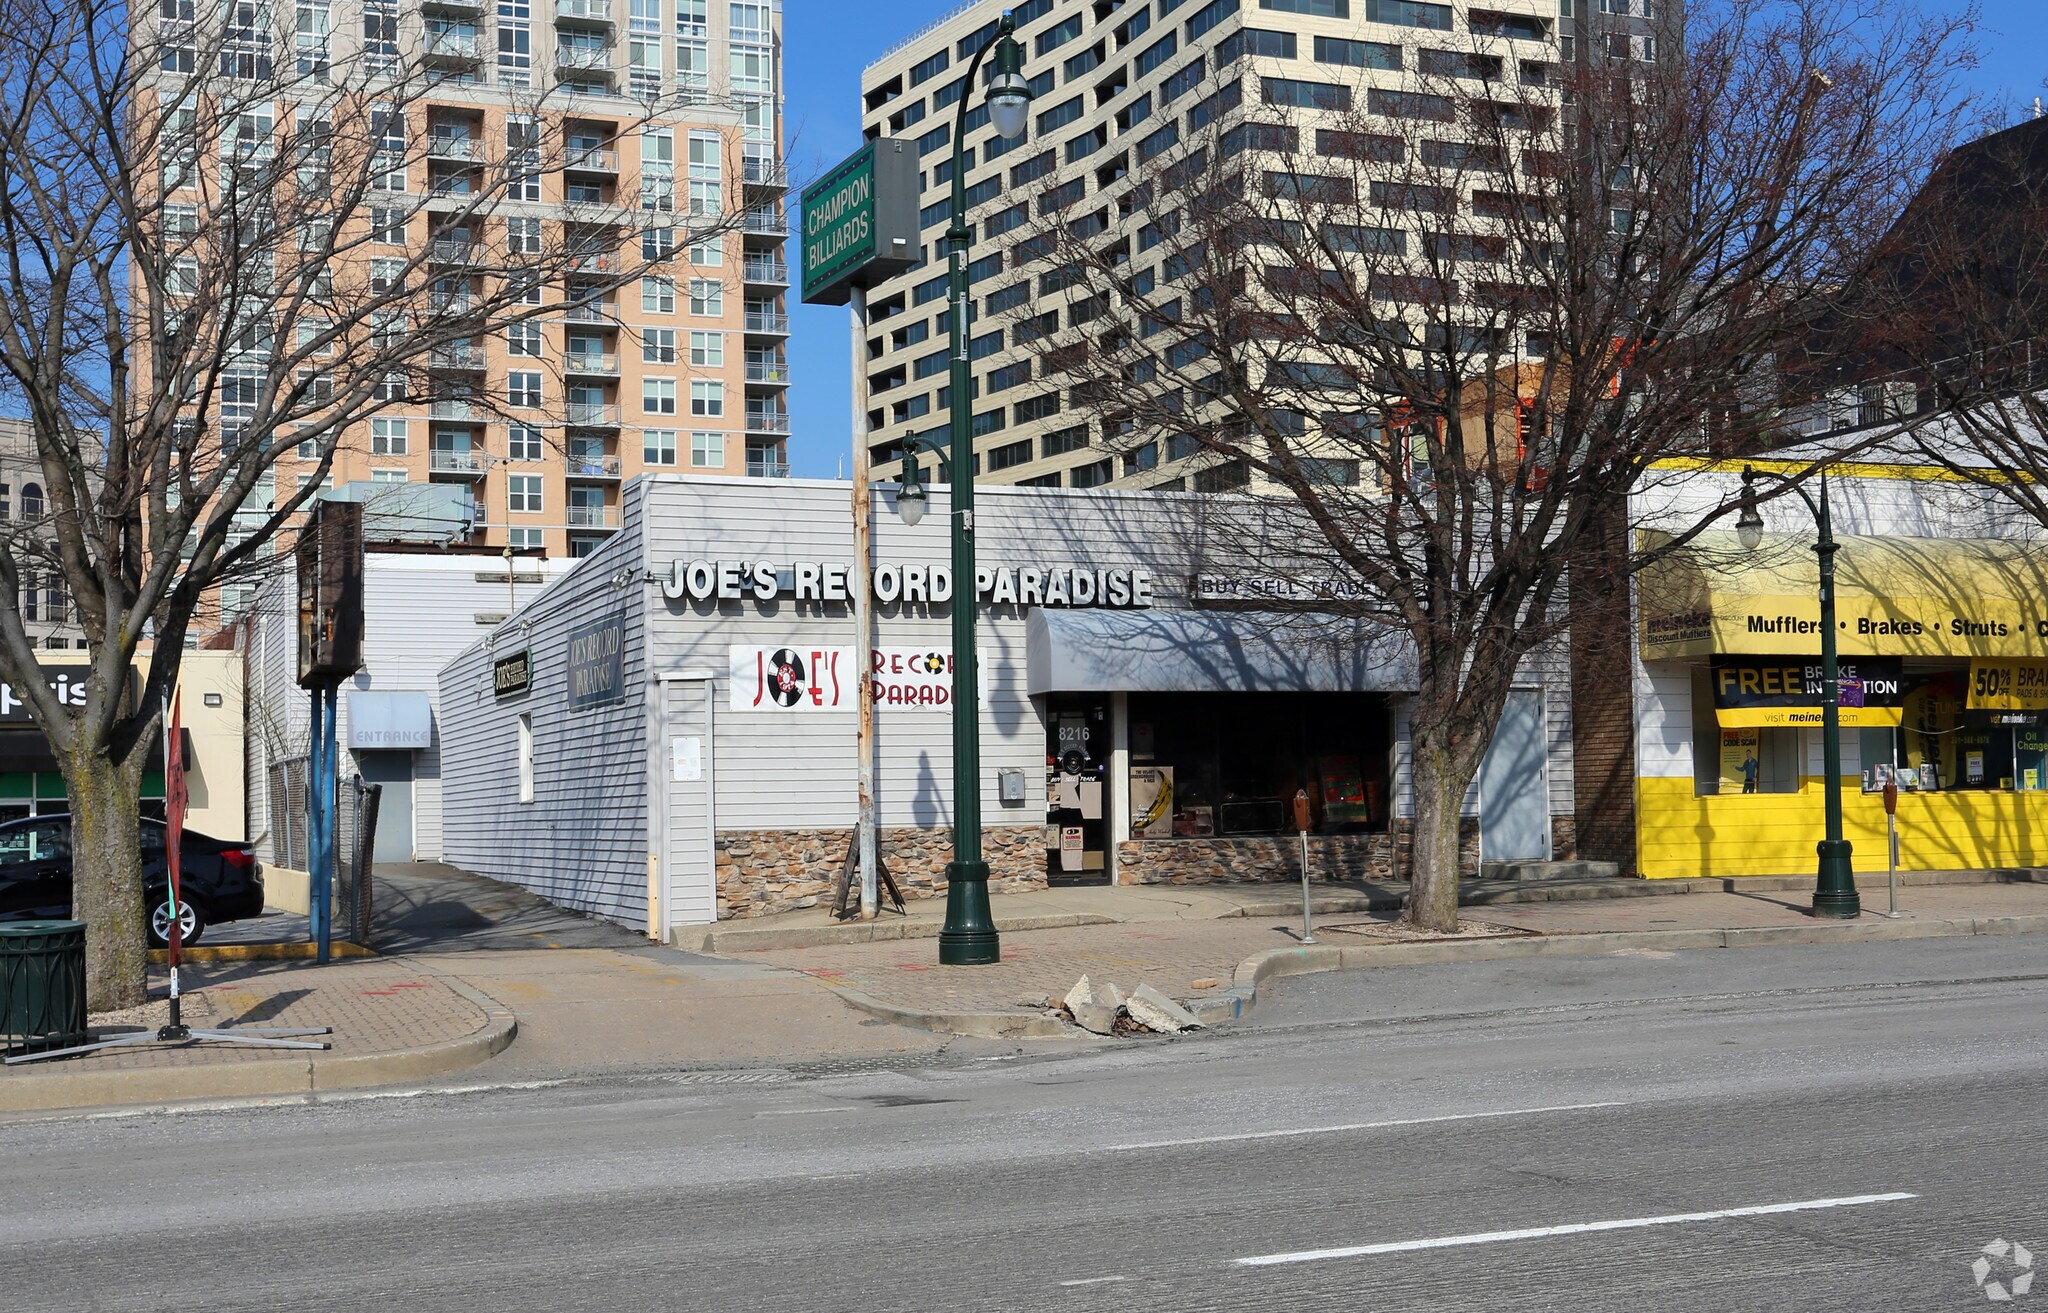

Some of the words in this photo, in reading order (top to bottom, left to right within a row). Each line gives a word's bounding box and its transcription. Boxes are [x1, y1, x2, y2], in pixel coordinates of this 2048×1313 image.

[808, 173, 869, 237] CHAMPION
[809, 210, 869, 271] BILLIARDS
[662, 559, 778, 600] JOE'S
[975, 565, 1153, 609] PARADISE
[1201, 579, 1240, 594] BUY
[1251, 580, 1299, 595] SELL
[1857, 617, 1923, 635] Brakes
[1951, 618, 2008, 637] Struts
[587, 626, 619, 661] RECORD
[1648, 632, 1679, 644] Discount
[1679, 627, 1711, 639] Mufflers
[576, 662, 611, 697] PARADISE
[1718, 667, 1803, 696] FREE
[1804, 665, 1857, 679] BRKE
[1998, 687, 2010, 696] OFF
[2016, 688, 2032, 698] PADS
[1764, 712, 1785, 723] visit
[356, 731, 429, 742] ENTRANCE
[1058, 727, 1090, 741] 8216
[1723, 731, 1740, 740] FREE
[2025, 732, 2037, 741] Oil
[1723, 738, 1740, 747] CODE
[1740, 738, 1757, 747] SCAN
